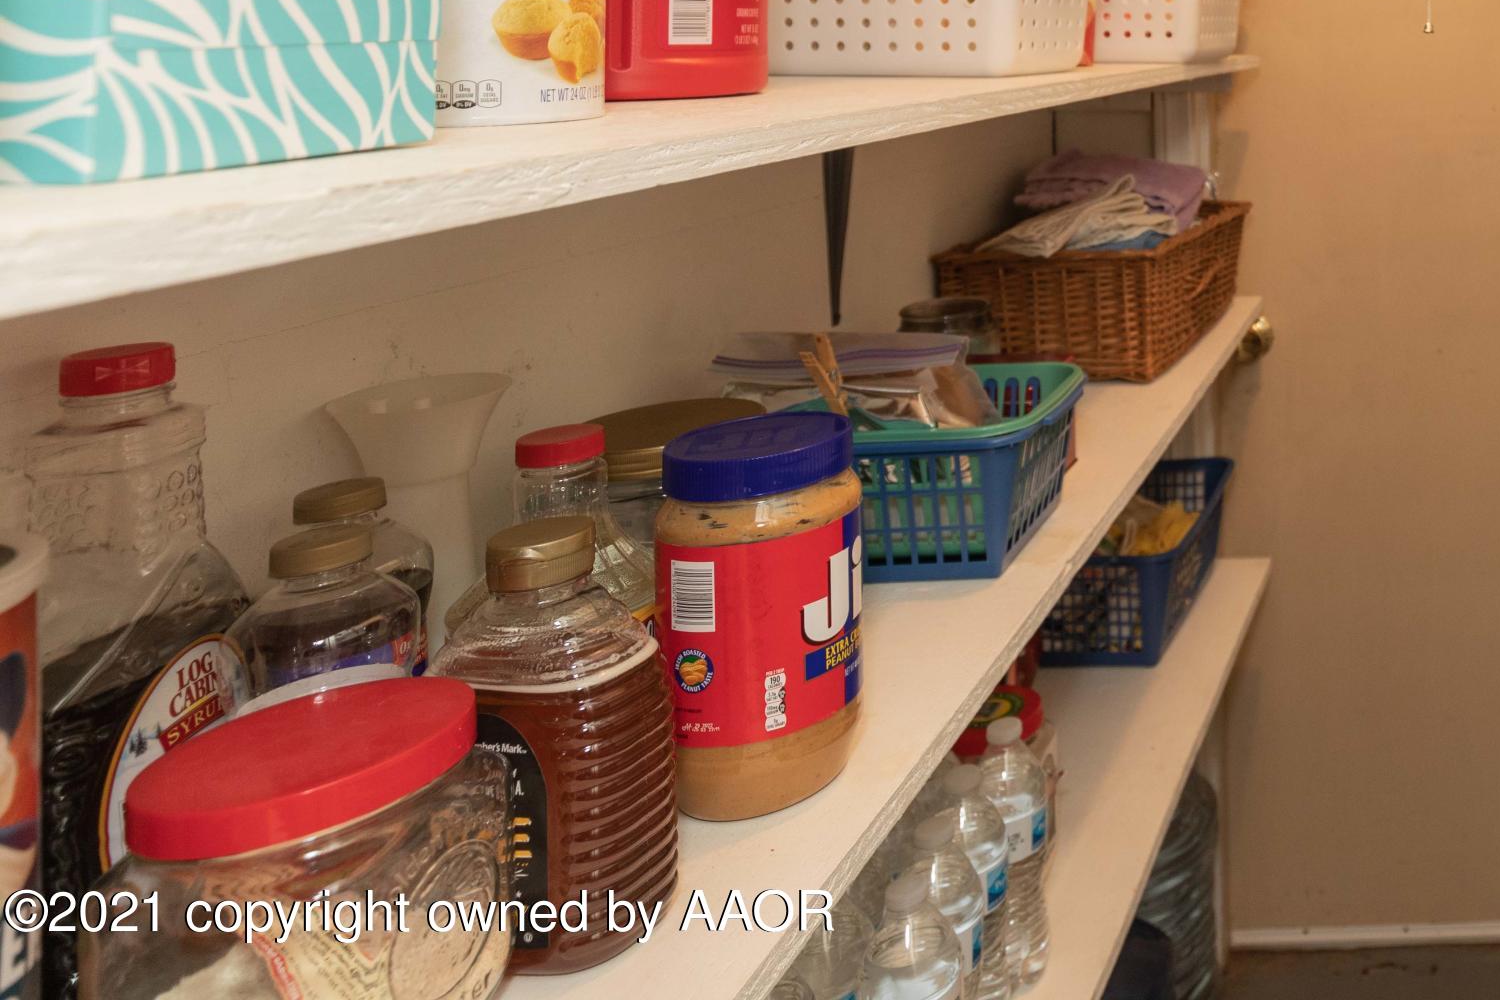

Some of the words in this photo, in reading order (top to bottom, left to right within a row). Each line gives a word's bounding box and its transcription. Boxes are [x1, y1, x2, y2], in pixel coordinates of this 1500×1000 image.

[541, 89, 556, 103] NET
[557, 88, 569, 102] WT
[801, 536, 862, 645] Ji
[682, 649, 706, 660] ROASTED
[825, 637, 849, 660] EXTRA
[825, 643, 854, 671] PEANUT
[175, 651, 214, 691] LOG
[770, 675, 780, 685] 190
[680, 682, 701, 693] PEANUT
